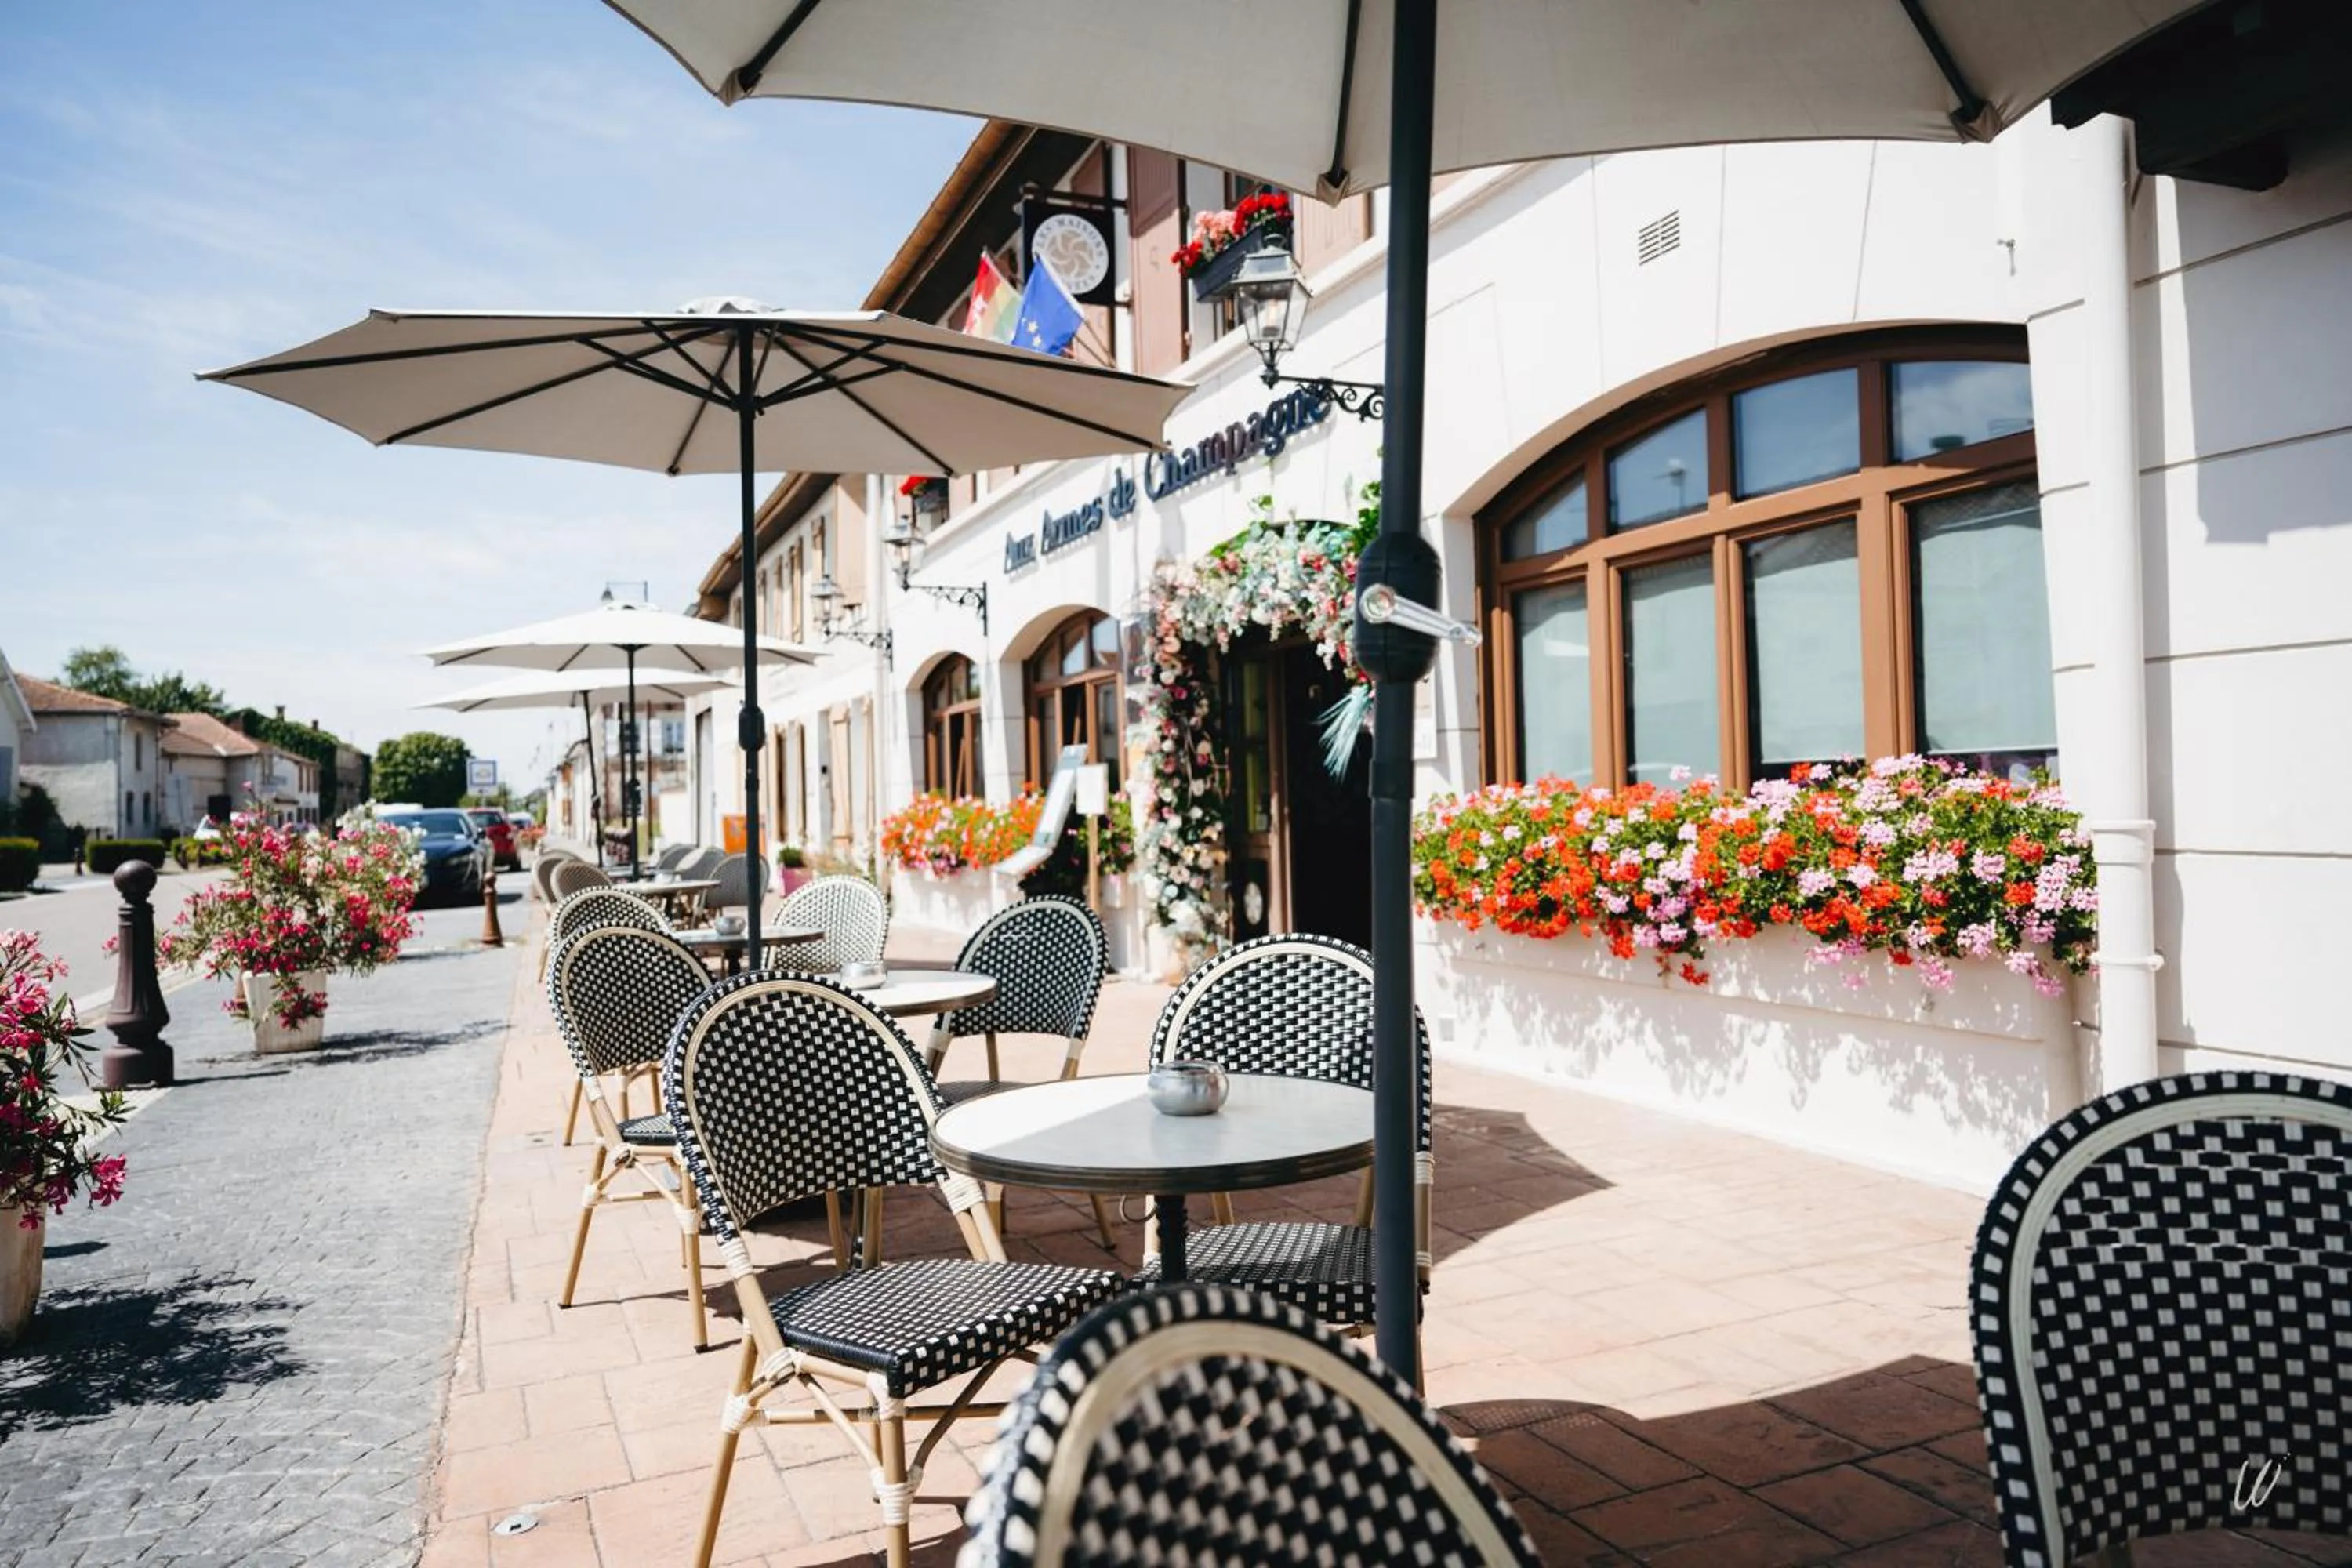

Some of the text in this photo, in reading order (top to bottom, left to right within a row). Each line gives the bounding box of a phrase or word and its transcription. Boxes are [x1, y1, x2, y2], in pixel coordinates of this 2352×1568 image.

[1004, 387, 1331, 574] Aux Armes de Champagne
